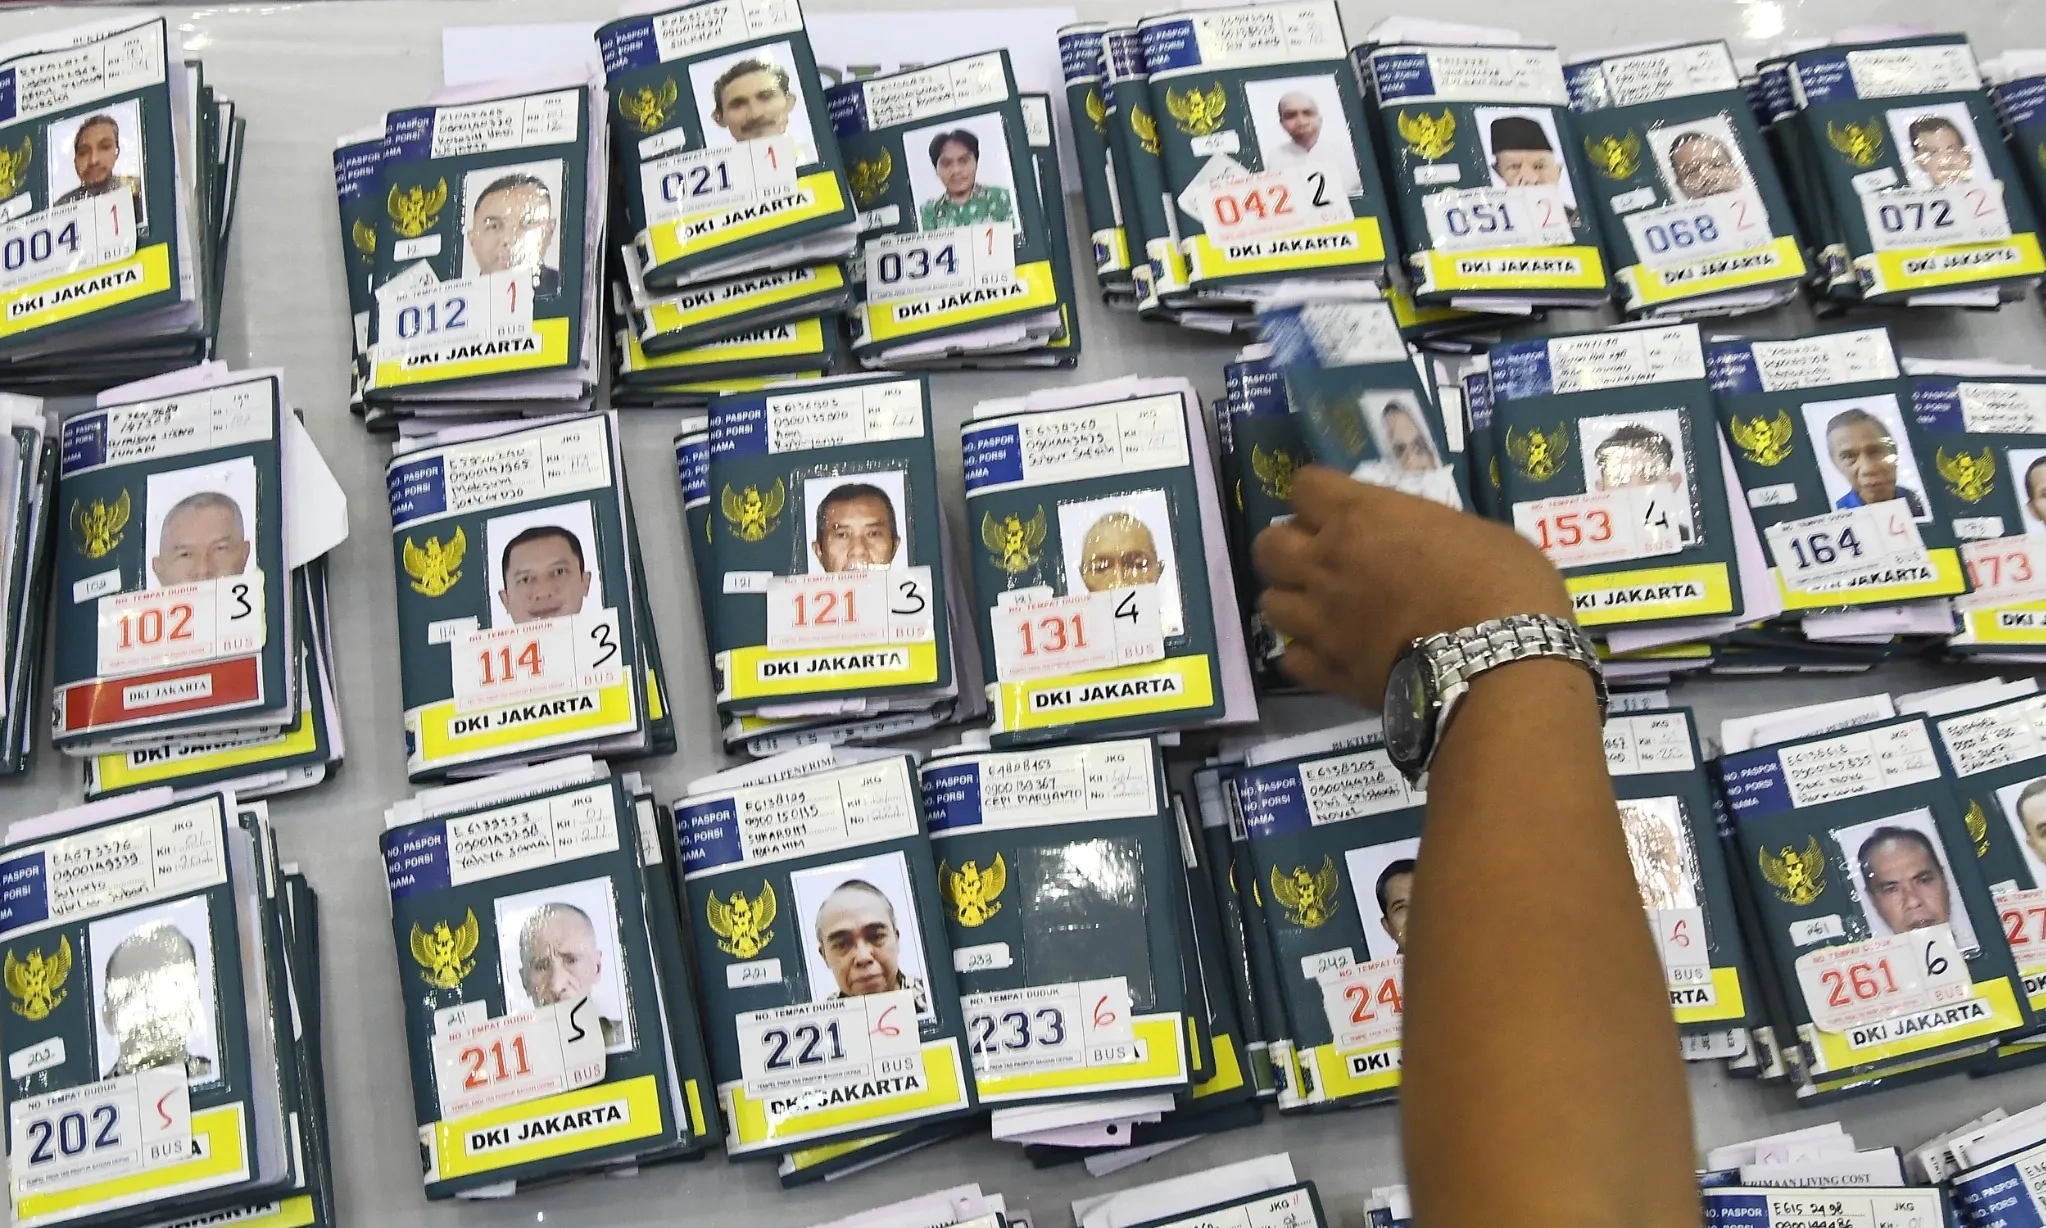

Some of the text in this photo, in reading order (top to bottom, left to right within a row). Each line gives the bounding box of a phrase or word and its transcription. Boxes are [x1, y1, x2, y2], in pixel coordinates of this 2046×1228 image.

[765, 145, 777, 171] 1
[660, 160, 735, 204] 021
[763, 185, 791, 197] BUS
[1307, 171, 1332, 208] 2
[721, 193, 808, 227] JAKARTA
[1213, 184, 1294, 227] 042
[1536, 196, 1561, 229] 2
[1964, 188, 1997, 220] 2
[110, 204, 120, 236] 1
[1446, 202, 1517, 236] 051
[1730, 200, 1755, 231] 2
[1879, 199, 1956, 234] 072
[985, 227, 994, 256] 1
[1644, 213, 1720, 255] 068
[3, 221, 80, 273] 004
[104, 245, 131, 261] BUS
[1229, 235, 1353, 259] DKI JAKARTA
[878, 243, 959, 285] 034
[1461, 261, 1577, 274] DKI JAKARTA
[682, 268, 808, 310] DKI JAKARTA
[981, 273, 1008, 285] BUS
[11, 268, 138, 317] DKI JAKARTA
[507, 279, 517, 314] 1
[899, 283, 1023, 319] DKI JAKARTA
[397, 297, 468, 338] 012
[498, 324, 525, 336] BUS
[446, 337, 536, 360] JAKARTA
[726, 410, 761, 425] PASPOR
[726, 425, 753, 437] PORSI
[977, 434, 1014, 449] PASPOR
[711, 442, 735, 455] NAMA
[978, 451, 1007, 465] PORSI
[404, 466, 438, 483] PASPOR
[965, 468, 989, 481] NAMA
[405, 484, 431, 496] PORSI
[392, 502, 414, 515] NAMA
[1643, 500, 1668, 528] 4
[1535, 509, 1614, 550] 153
[1888, 514, 1910, 546] 4
[1789, 527, 1863, 569] 164
[1848, 567, 1931, 587] JAKARTA
[1967, 552, 2031, 589] 173
[229, 583, 252, 621] 3
[792, 589, 858, 628] 121
[891, 581, 925, 614] 3
[1114, 591, 1139, 624] 4
[1573, 585, 1697, 610] KI JAKARTA
[117, 602, 195, 651] 102
[2003, 613, 2033, 626] DKI
[896, 627, 925, 638] BUS
[1018, 613, 1089, 656] 131
[223, 638, 253, 651] BUS
[591, 624, 617, 667] 3
[1125, 644, 1154, 658] BUS
[479, 639, 544, 686] 114
[764, 653, 902, 677] DKI JAKARTA
[584, 672, 614, 685] BUS
[129, 680, 207, 703] DKI JAKARTA
[1036, 678, 1175, 708] DKI JAKARTA
[454, 696, 593, 735] DKI JAKARTA
[132, 747, 171, 764] DKI
[1105, 754, 1125, 764] JKG
[936, 774, 974, 788] PASPOR
[1740, 763, 1778, 778] PASPOR
[861, 776, 882, 788] JKG
[1257, 779, 1297, 795] PASPOR
[1745, 779, 1773, 792] PORSI
[571, 795, 593, 808] JKG
[936, 792, 965, 806] PORSI
[1260, 796, 1291, 810] PORSI
[172, 821, 194, 834] JKG
[692, 809, 730, 827] PASPOR
[1247, 814, 1275, 826] NAMA
[403, 836, 441, 855] PASPOR
[694, 827, 723, 842] PORSI
[405, 854, 434, 870] PORSI
[2, 866, 39, 885] PASPOR
[391, 876, 416, 891] NAMA
[3, 886, 31, 901] PORSI
[1670, 919, 1690, 947] 6
[1318, 957, 1349, 974] 242
[1926, 940, 1948, 977] 6
[1674, 969, 1703, 981] BUS
[1821, 958, 1901, 1009] 261
[988, 992, 1024, 1004] TEMPAT
[1026, 988, 1060, 1000] DUDUK
[1936, 986, 1964, 1002] BUS
[568, 996, 588, 1043] 5
[775, 1006, 810, 1020] TEMPAT
[812, 1001, 846, 1013] DUDUK
[873, 1004, 900, 1036] 6
[1093, 995, 1116, 1031] 6
[467, 1022, 500, 1038] TEMPAT
[968, 1007, 1067, 1057] 233
[1853, 1003, 1985, 1047] DKI JAKARTA
[761, 1016, 847, 1073] 221
[1094, 1048, 1127, 1062] BUS
[460, 1033, 533, 1091] 211
[573, 1063, 602, 1083] BUS
[882, 1057, 914, 1074] BUS
[1353, 1052, 1390, 1074] DKI
[47, 1084, 117, 1107] TEMPAT DUDUK
[817, 1075, 920, 1108] JAKARTA
[157, 1088, 181, 1130] 5
[27, 1104, 120, 1168] 202
[471, 1105, 621, 1151] DKI JAKARTA
[150, 1140, 183, 1160] BUS
[1799, 1173, 1871, 1187] LIVING COST
[1983, 1178, 2020, 1198] PASPOR
[1269, 1199, 1289, 1213] JKG
[1721, 1207, 1763, 1217] PASPOR
[1894, 1202, 1915, 1211] JKG
[1989, 1197, 2018, 1214] PORSI
